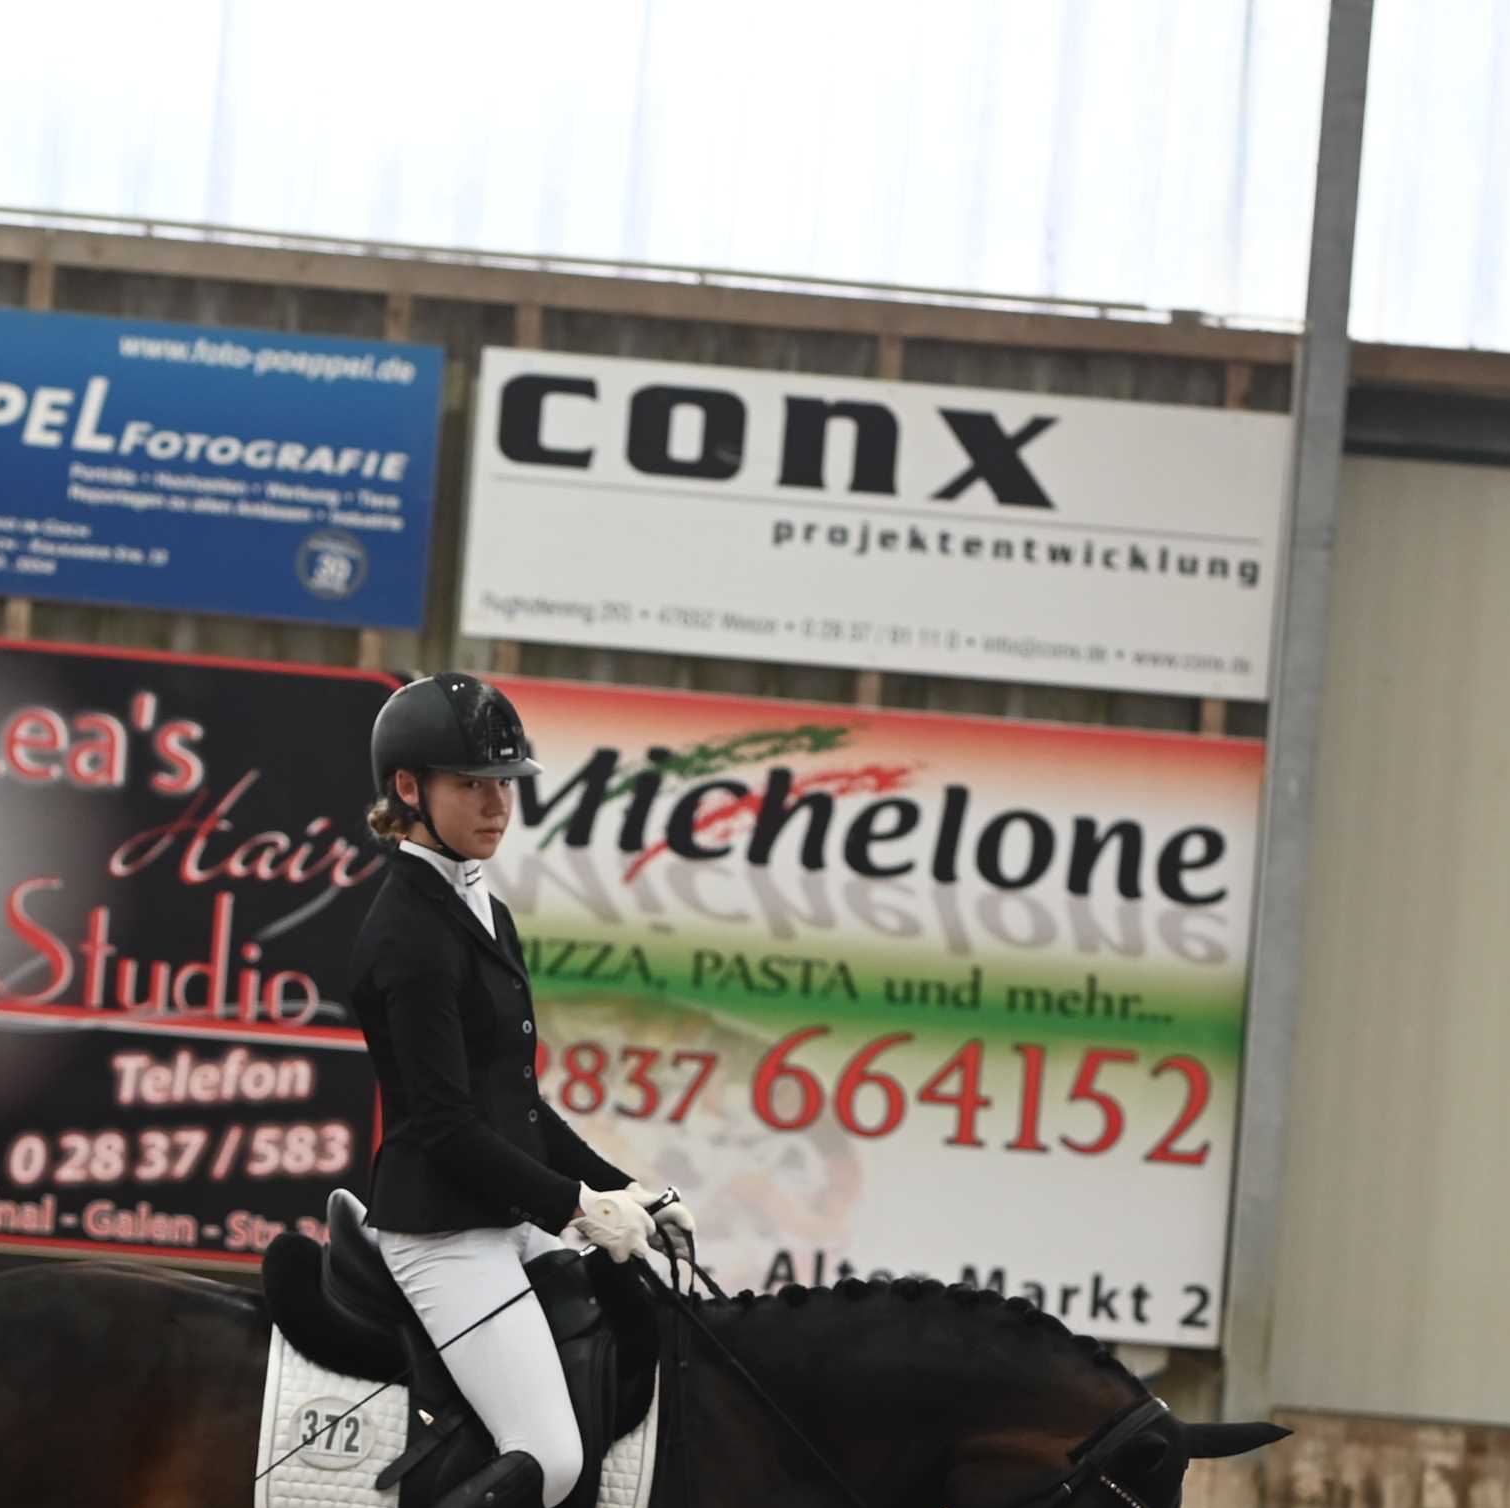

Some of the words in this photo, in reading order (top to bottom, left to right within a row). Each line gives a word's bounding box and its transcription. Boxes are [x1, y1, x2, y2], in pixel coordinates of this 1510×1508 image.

[118, 335, 417, 386] www.foto-poeppel.de
[495, 372, 1061, 513] conx
[771, 518, 1262, 589] projektentwicklung
[108, 766, 388, 888] Hair
[516, 745, 1229, 909] Michelone
[692, 947, 861, 1003] PASTA
[883, 968, 984, 1012] und
[112, 1048, 315, 1107] Telefon
[750, 1024, 1215, 1168] 664152
[8, 1133, 46, 1185] 0
[53, 1130, 128, 1183] 28
[133, 1126, 207, 1181] 37
[247, 1122, 352, 1177] 583
[83, 1199, 199, 1249] Galen
[1179, 1283, 1213, 1329] 2
[302, 1408, 361, 1453] 372
